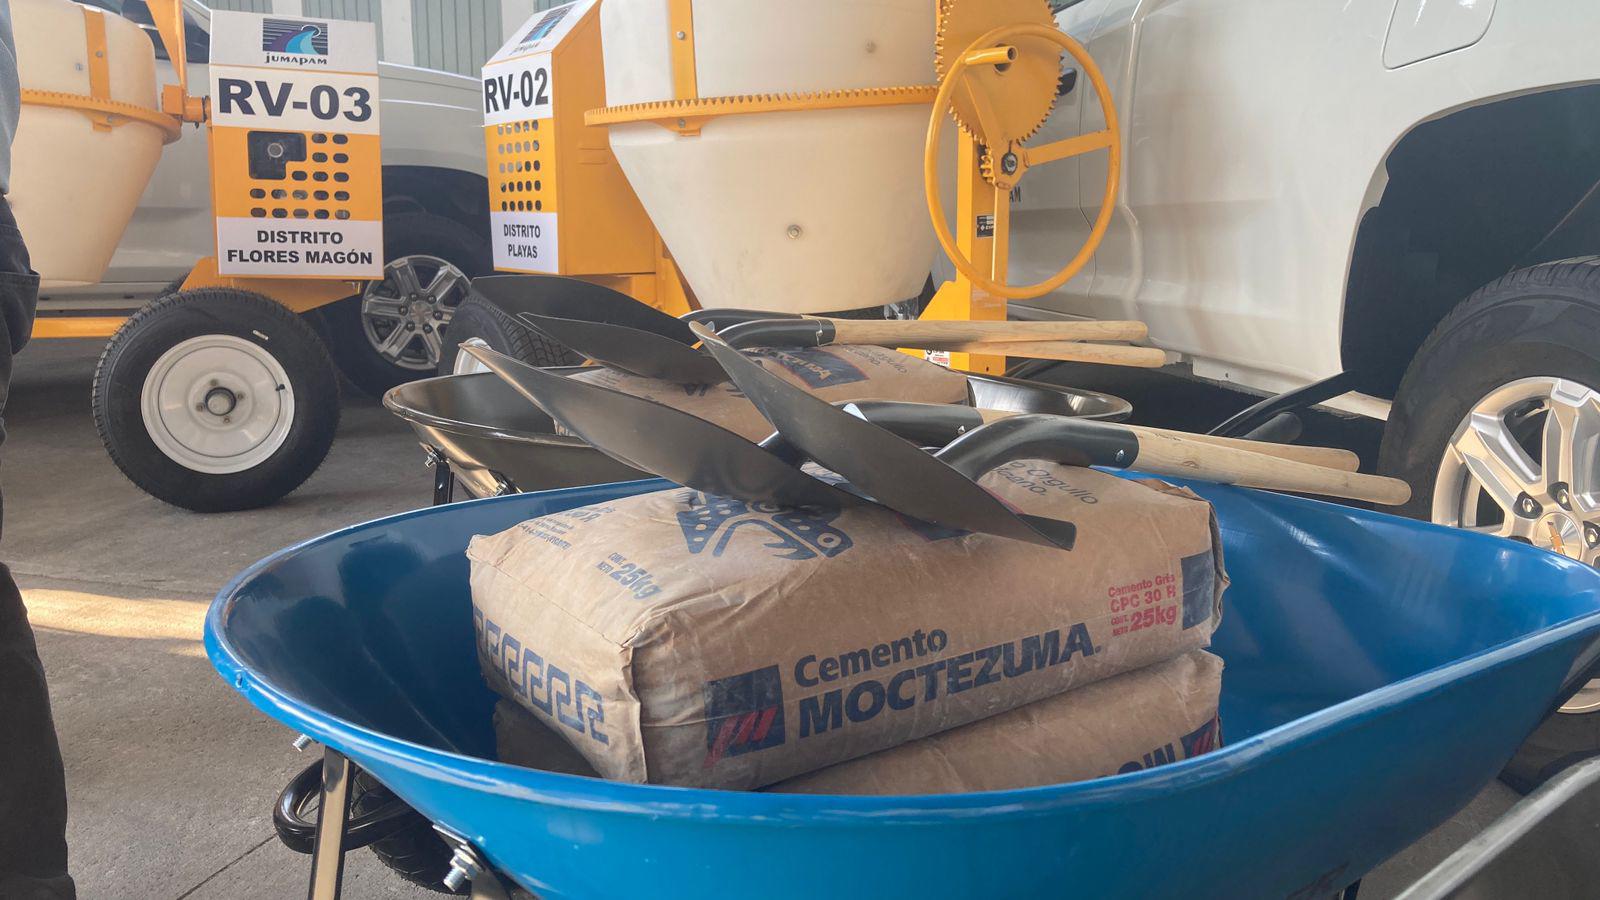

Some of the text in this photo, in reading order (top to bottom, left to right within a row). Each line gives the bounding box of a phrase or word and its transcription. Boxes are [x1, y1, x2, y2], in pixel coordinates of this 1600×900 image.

[218, 77, 373, 123] RV-03
[484, 67, 549, 114] RV-02
[257, 229, 344, 245] DISTRITO
[503, 223, 541, 239] DISTRITO
[227, 247, 373, 265] FLORES MAGÓN
[508, 244, 538, 259] PLAYAS
[1027, 469, 1098, 504] Orgullo
[609, 562, 663, 600] 25kg
[1108, 579, 1153, 598] Cemento
[1111, 593, 1140, 613] CPC
[1144, 588, 1162, 604] 30
[1130, 605, 1177, 632] 25kg
[794, 628, 947, 687] Cemento
